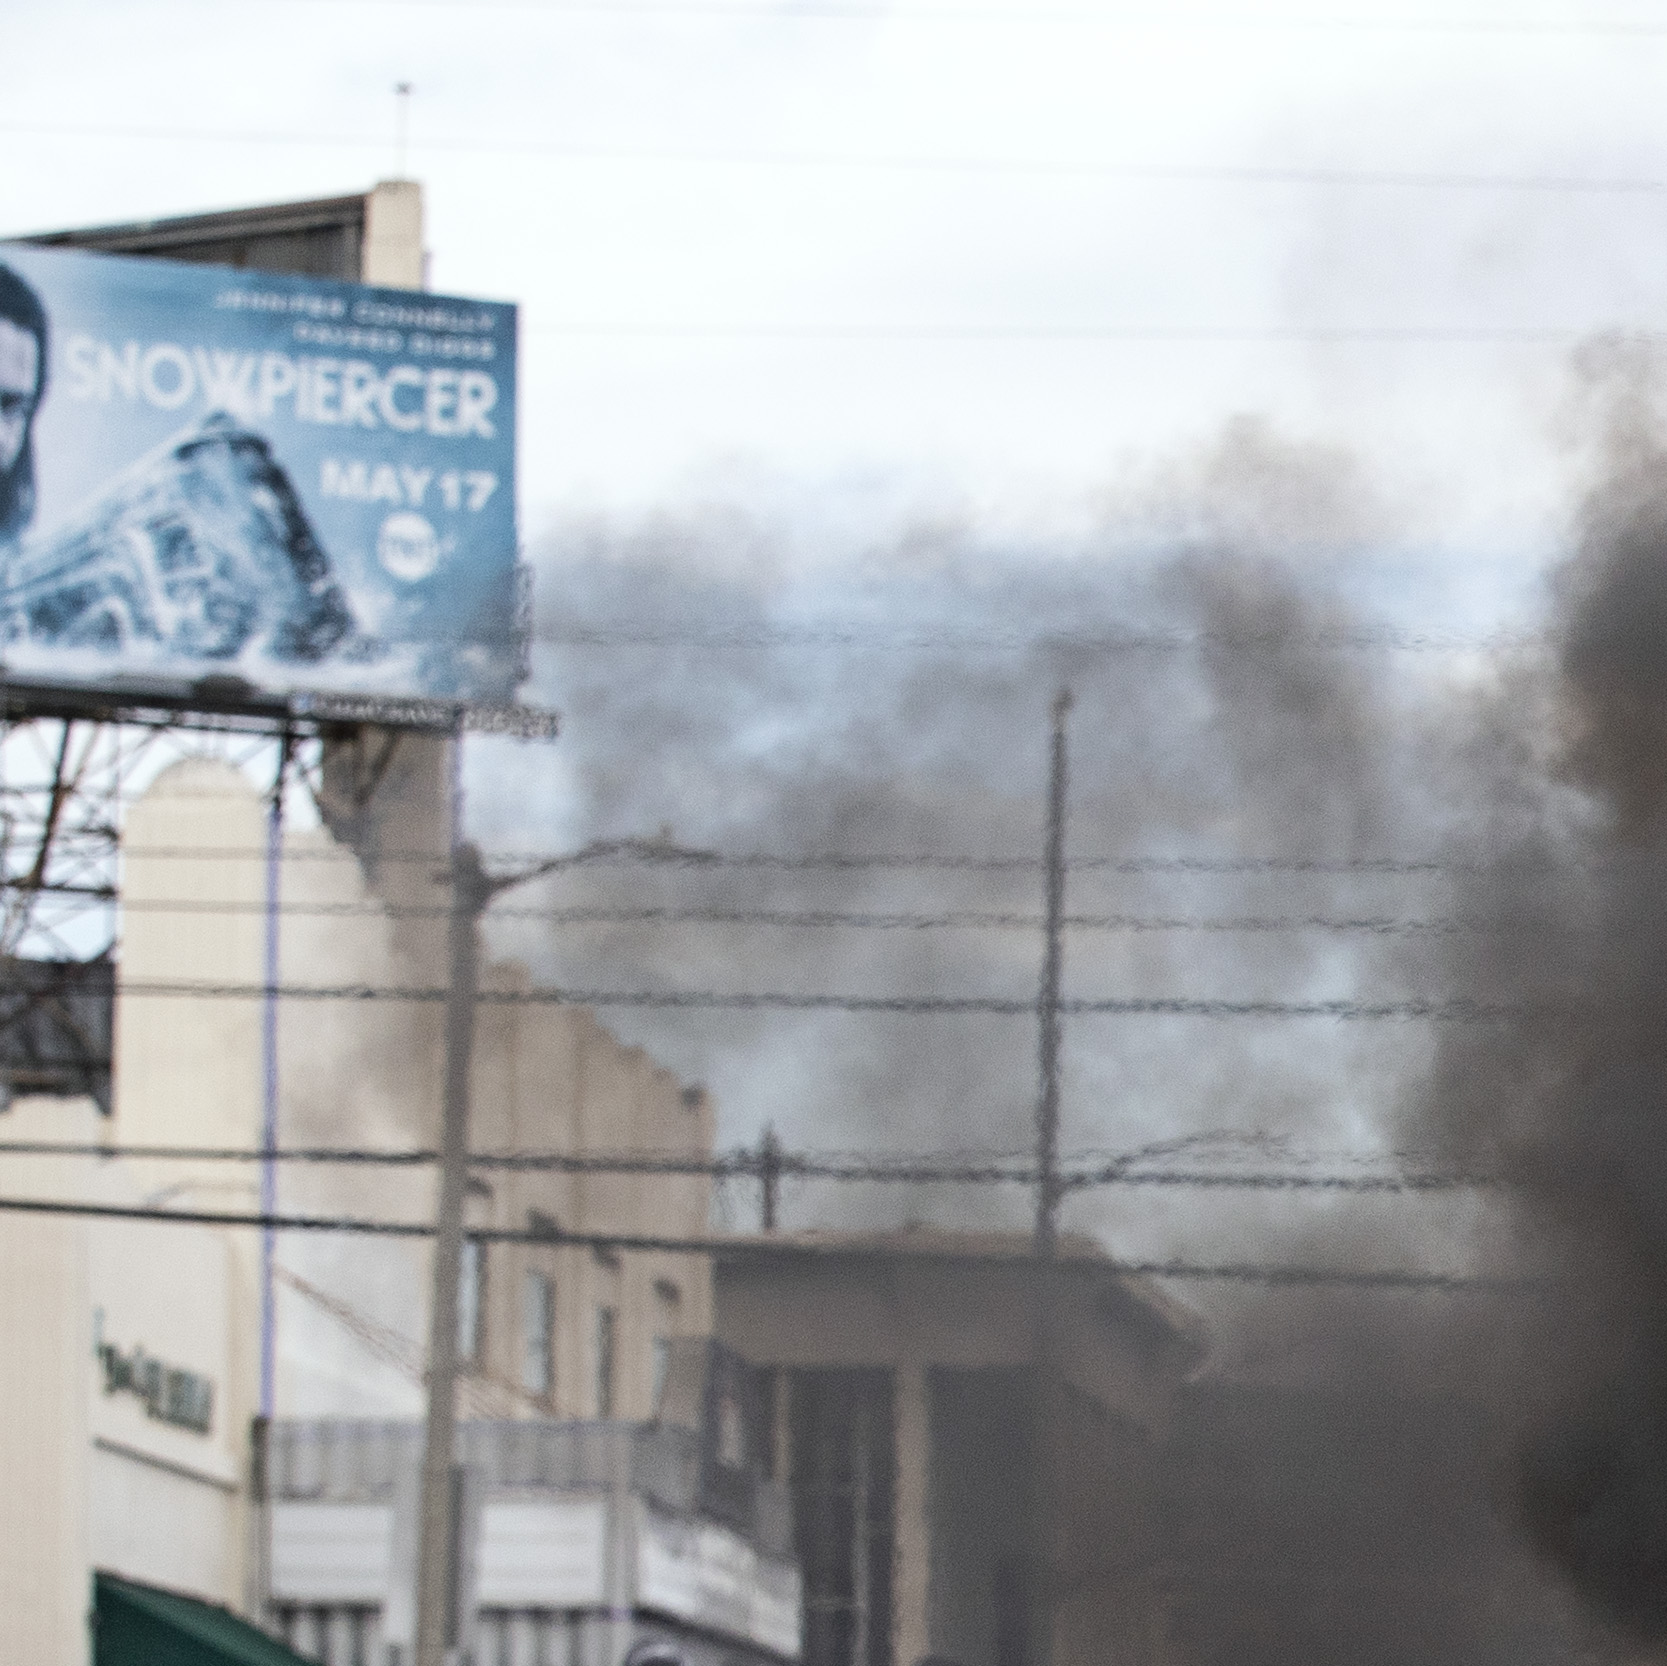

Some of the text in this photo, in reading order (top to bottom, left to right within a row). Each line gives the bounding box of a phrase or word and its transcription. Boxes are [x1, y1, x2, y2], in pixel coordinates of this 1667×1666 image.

[65, 333, 499, 440] SNOWPIERCER
[320, 459, 499, 512] MAY 17
